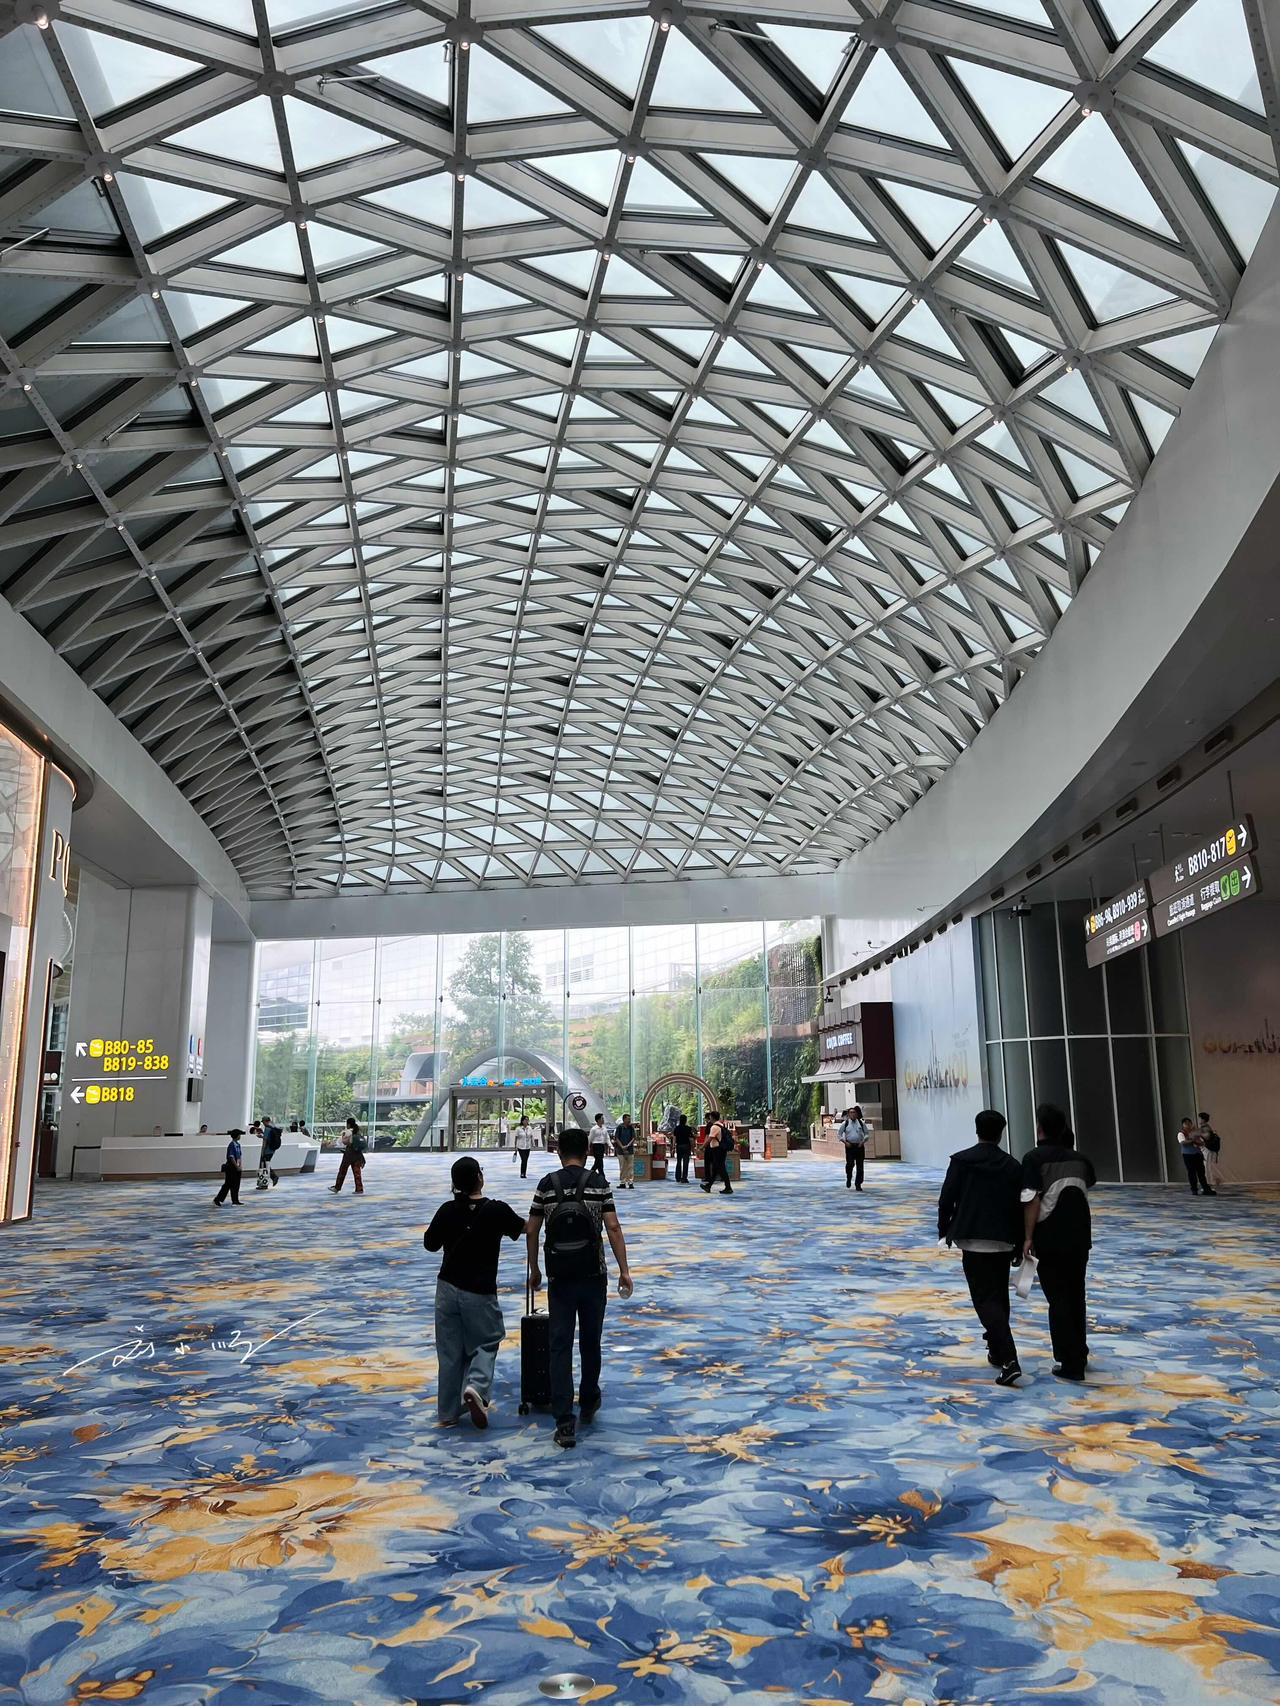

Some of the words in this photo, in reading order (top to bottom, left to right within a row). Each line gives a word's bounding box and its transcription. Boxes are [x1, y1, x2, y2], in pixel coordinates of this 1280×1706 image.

[1187, 836, 1226, 876] B810-817
[104, 1039, 154, 1055] B80-85
[103, 1055, 169, 1072] B819-838
[101, 1087, 134, 1102] B818
